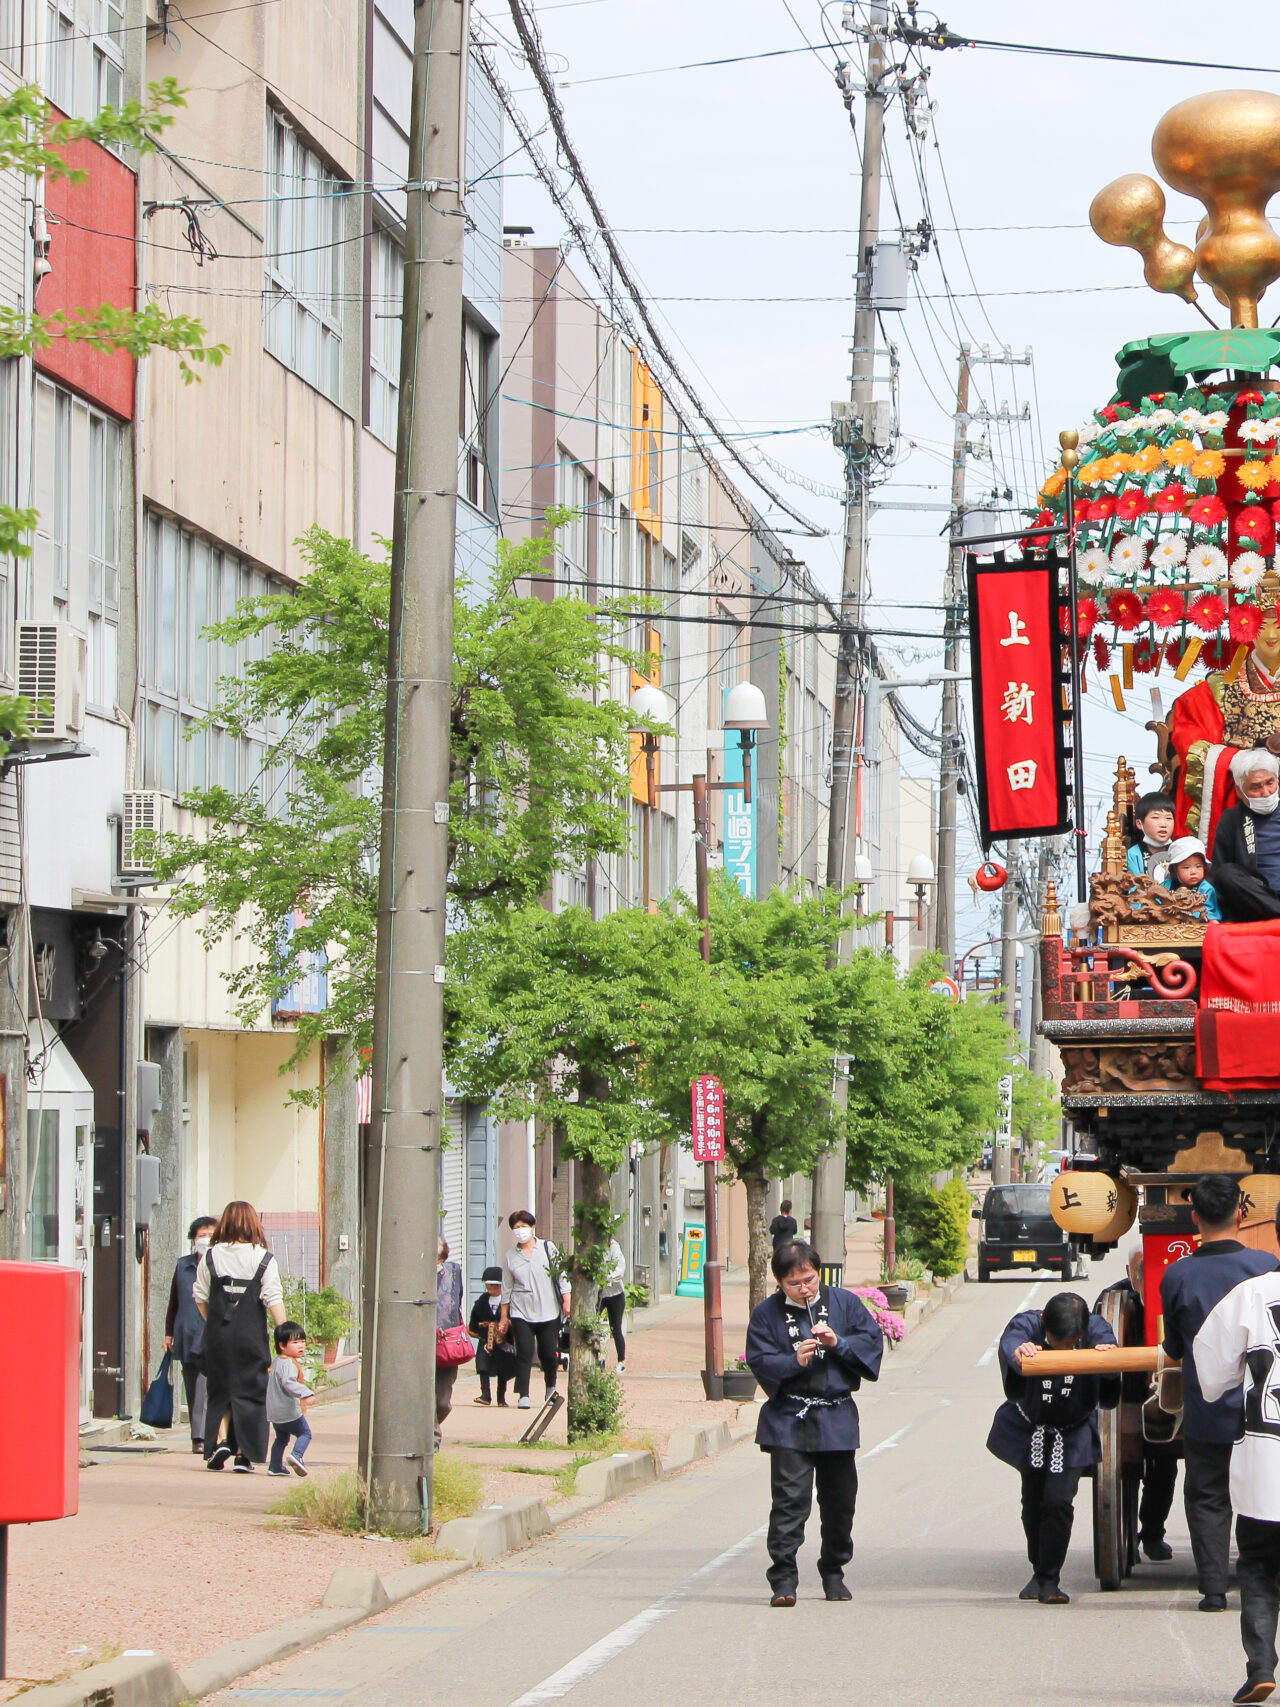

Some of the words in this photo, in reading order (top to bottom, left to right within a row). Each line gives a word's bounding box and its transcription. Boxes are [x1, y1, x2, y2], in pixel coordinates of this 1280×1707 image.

[1000, 611, 1037, 791] 上新田
[1243, 816, 1256, 854] 上新田町
